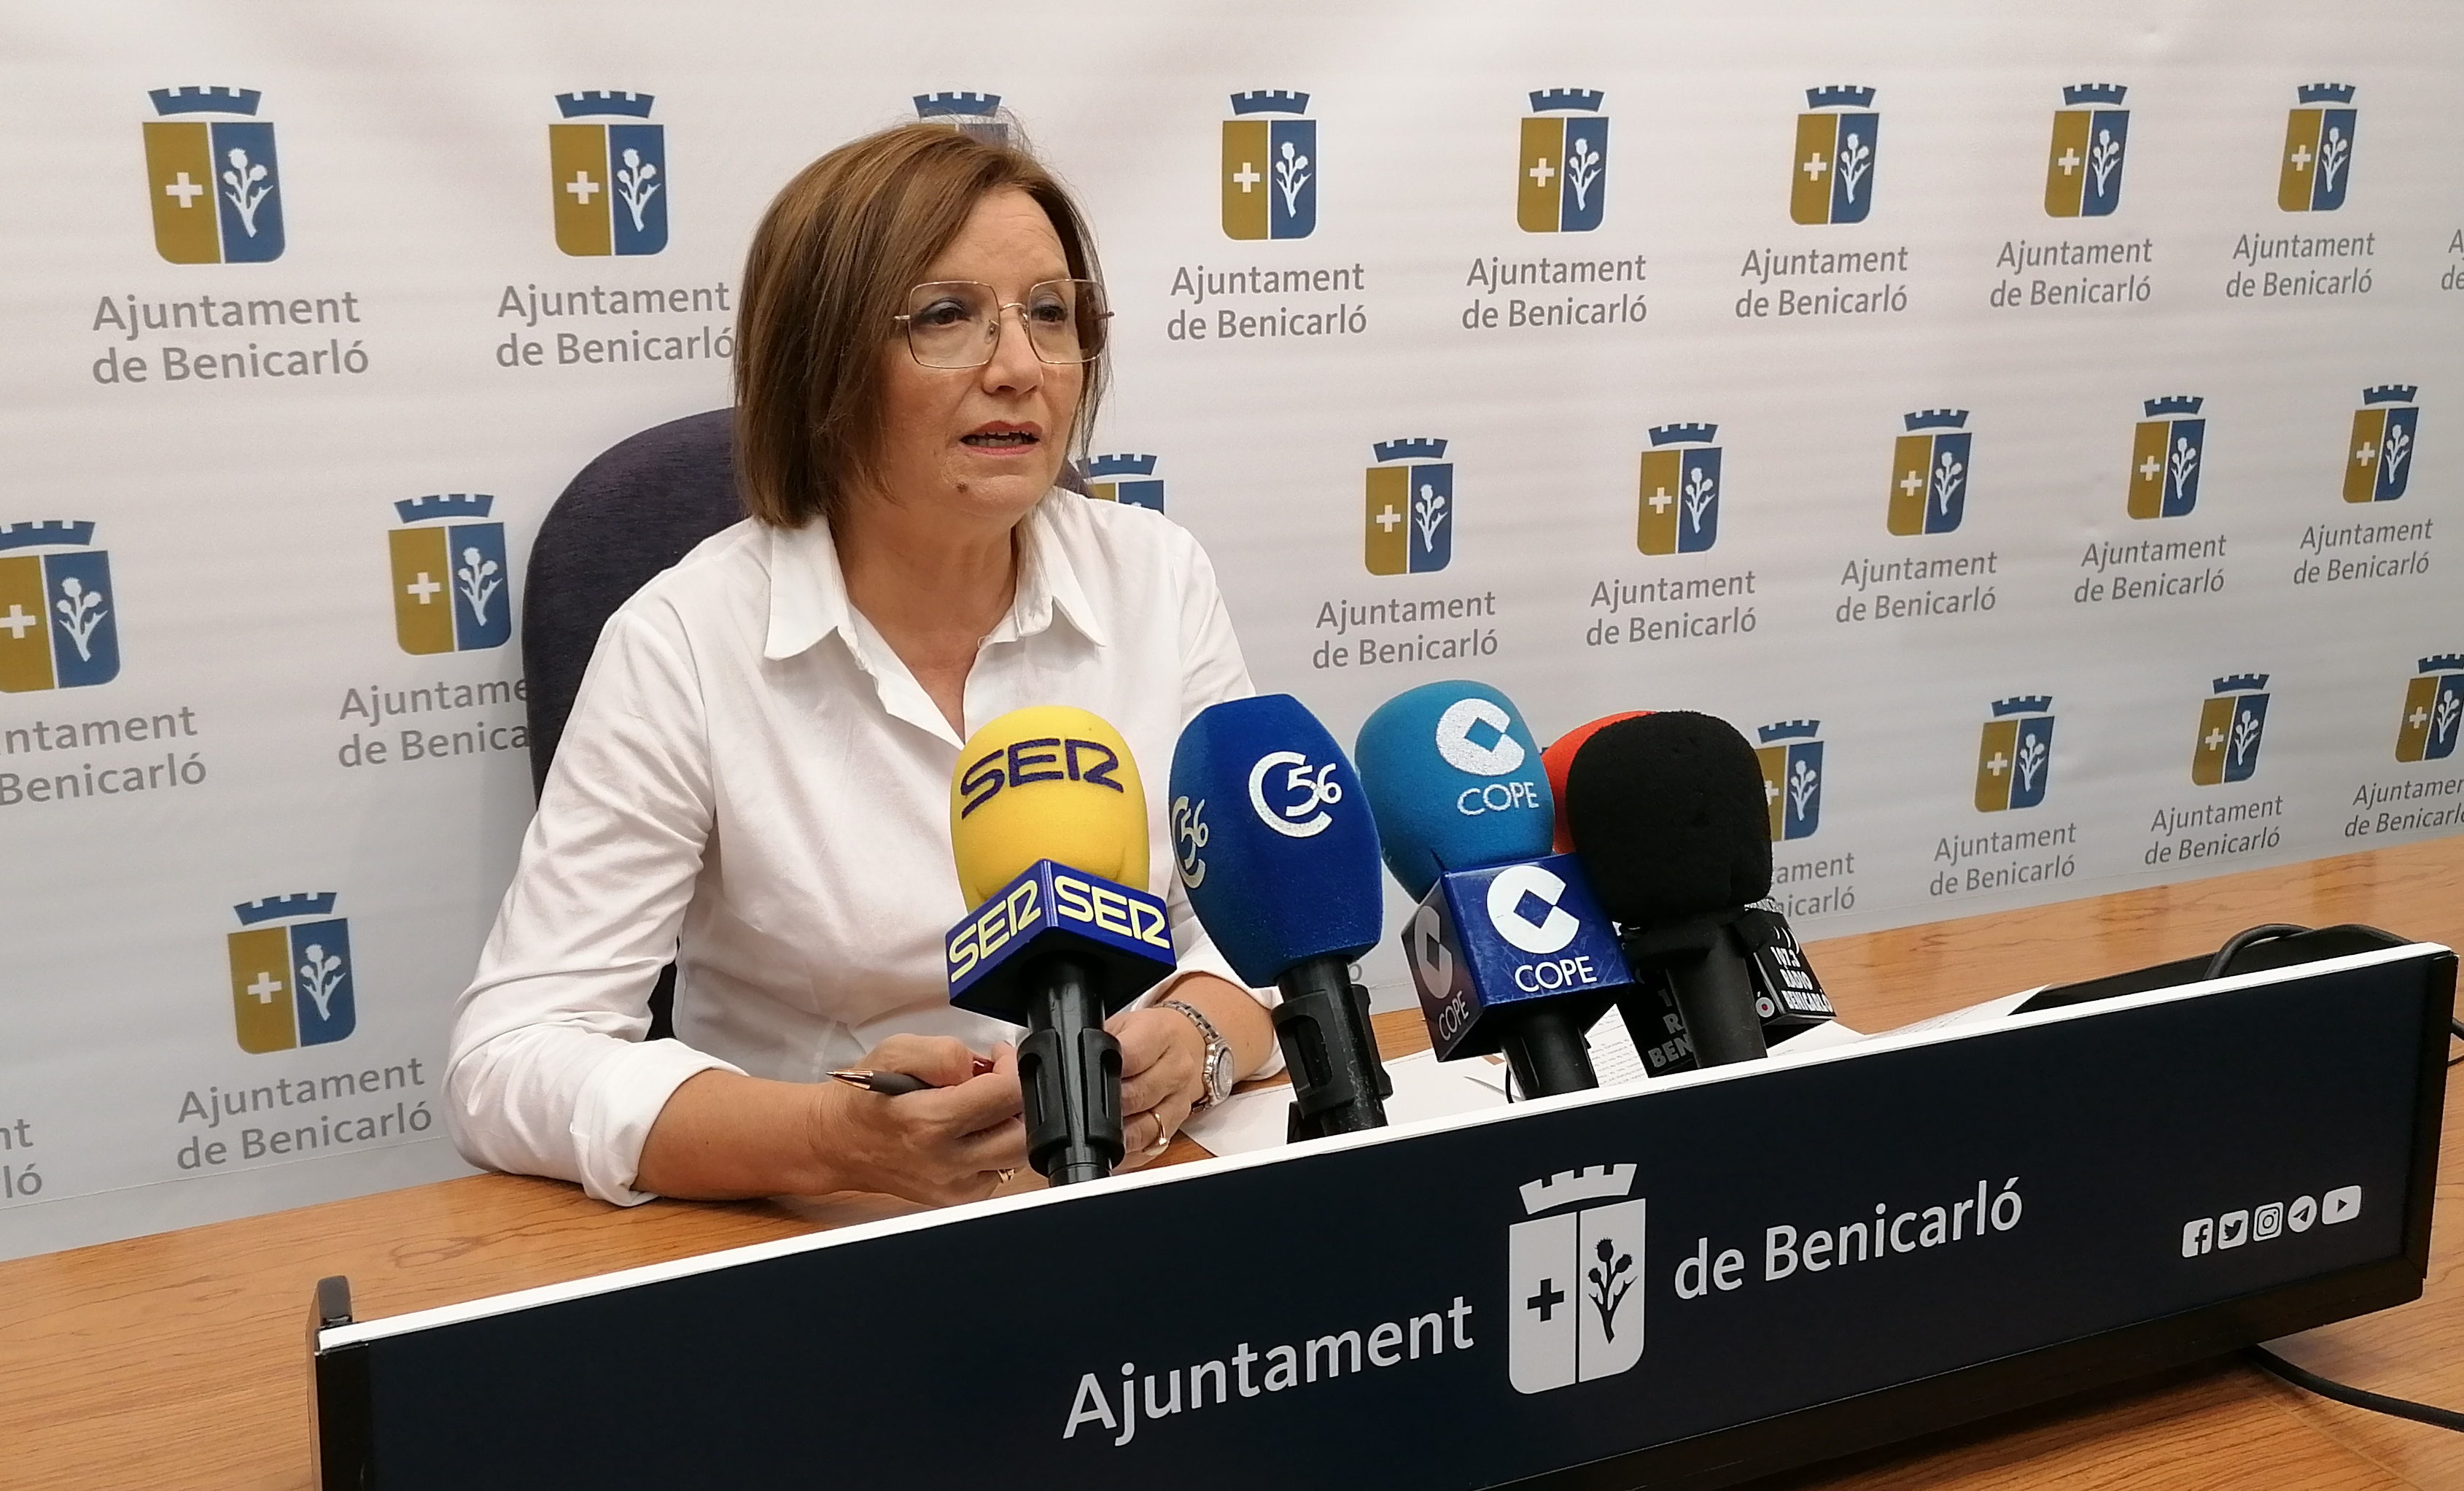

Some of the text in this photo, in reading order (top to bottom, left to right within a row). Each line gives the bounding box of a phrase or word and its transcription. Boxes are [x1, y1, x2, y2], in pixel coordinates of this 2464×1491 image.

[1741, 247, 1908, 285] Ajuntament
[1997, 239, 2153, 275] Ajuntament
[2233, 233, 2375, 267] Ajuntament
[1170, 263, 1364, 304] Ajuntament
[1466, 255, 1646, 294] Ajuntament
[1990, 274, 2150, 308] de Benicarló
[2226, 267, 2372, 298] de Benicarló
[93, 292, 361, 341] Ajuntament
[497, 282, 730, 327] Ajuntament
[1167, 303, 1367, 340] de Benicarló
[1463, 293, 1647, 329] de Benicarló
[1736, 284, 1907, 318] de Benicarló
[93, 339, 368, 384] de Benicarló
[497, 326, 734, 367] de Benicarló
[2081, 535, 2226, 574] Ajuntament
[2300, 519, 2433, 556] Ajuntament
[1841, 551, 1997, 592] Ajuntament
[2075, 568, 2223, 603] de Benicarló
[2294, 551, 2428, 584] de Benicarló
[1315, 592, 1496, 635] Ajuntament
[1590, 570, 1755, 617] Ajuntament
[1836, 586, 1995, 623] de Benicarló
[1587, 607, 1756, 646] de Benicarló
[1313, 629, 1497, 669] de Benicarló
[340, 678, 526, 727] Ajuntame
[5, 707, 198, 754] ntament
[339, 721, 530, 767] de Benica
[961, 737, 1124, 820] SER
[1457, 781, 1539, 816] COPE
[2151, 795, 2282, 837] Ajuntament
[2345, 802, 2464, 837] de Benicarl
[1934, 823, 2076, 867] Ajuntament
[2145, 826, 2280, 864] de Benicarló
[1930, 854, 2075, 896] de Benicarló
[949, 880, 1041, 983] SER
[1054, 875, 1170, 949] SER
[1515, 956, 1597, 992] COPE
[1439, 990, 1469, 1042] COPE
[178, 1058, 425, 1128] Ajuntament
[177, 1101, 431, 1169] de Benicarló
[1063, 1177, 2021, 1446] Ajuntament de Benicarló
